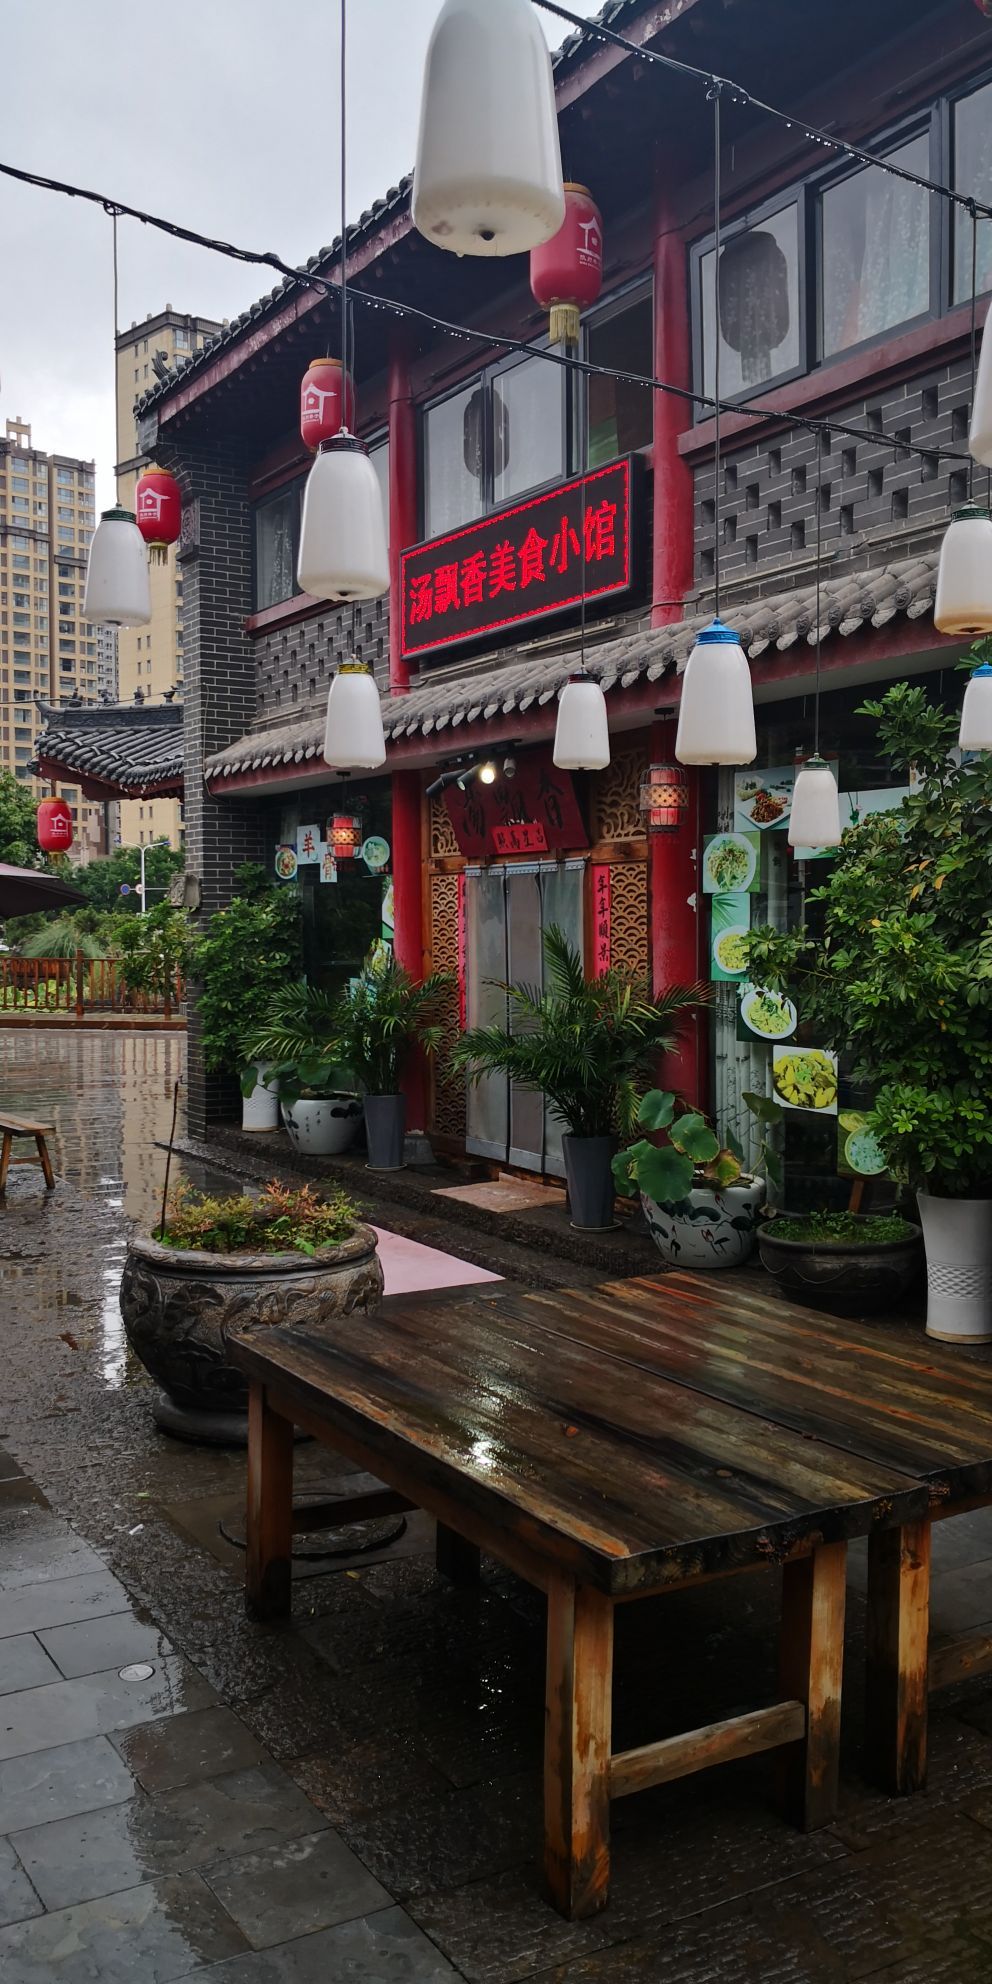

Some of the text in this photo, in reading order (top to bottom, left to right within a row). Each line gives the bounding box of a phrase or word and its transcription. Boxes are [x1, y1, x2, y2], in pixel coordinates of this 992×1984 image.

[409, 500, 617, 624] 汤飘香美食小馆
[303, 831, 315, 858] 羊
